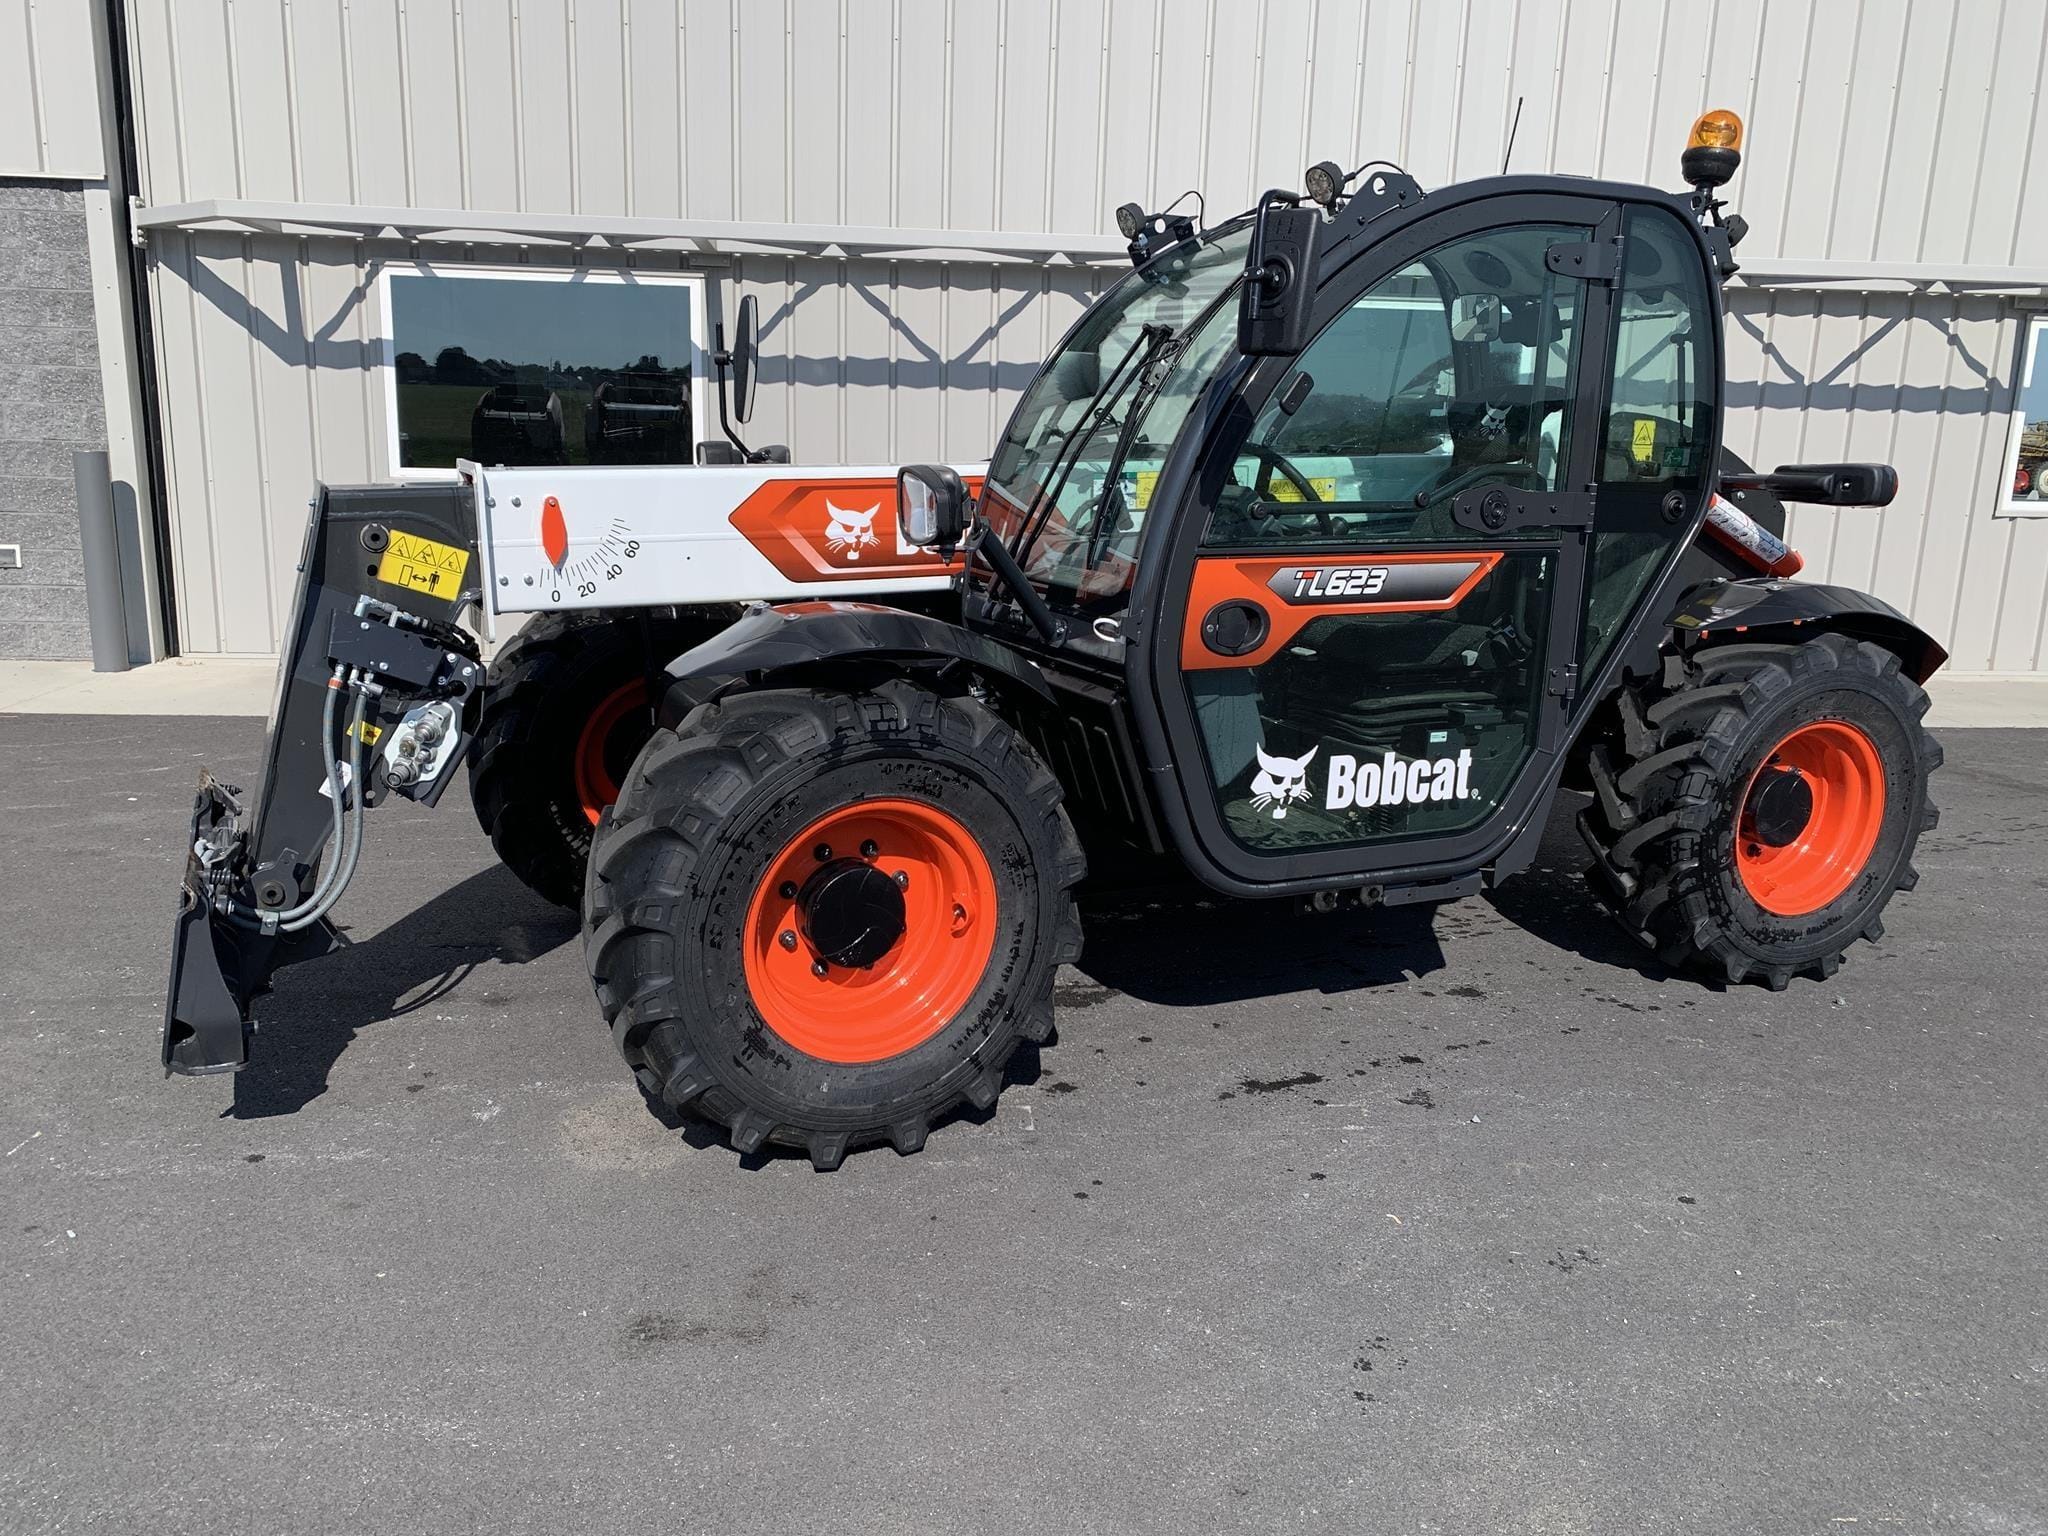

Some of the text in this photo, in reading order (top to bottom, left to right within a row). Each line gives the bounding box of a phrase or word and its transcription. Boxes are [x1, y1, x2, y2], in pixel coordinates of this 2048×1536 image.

[551, 540, 640, 602] 0 20 40 60
[1294, 568, 1389, 598] TL623
[1326, 749, 1472, 810] Bobcat
